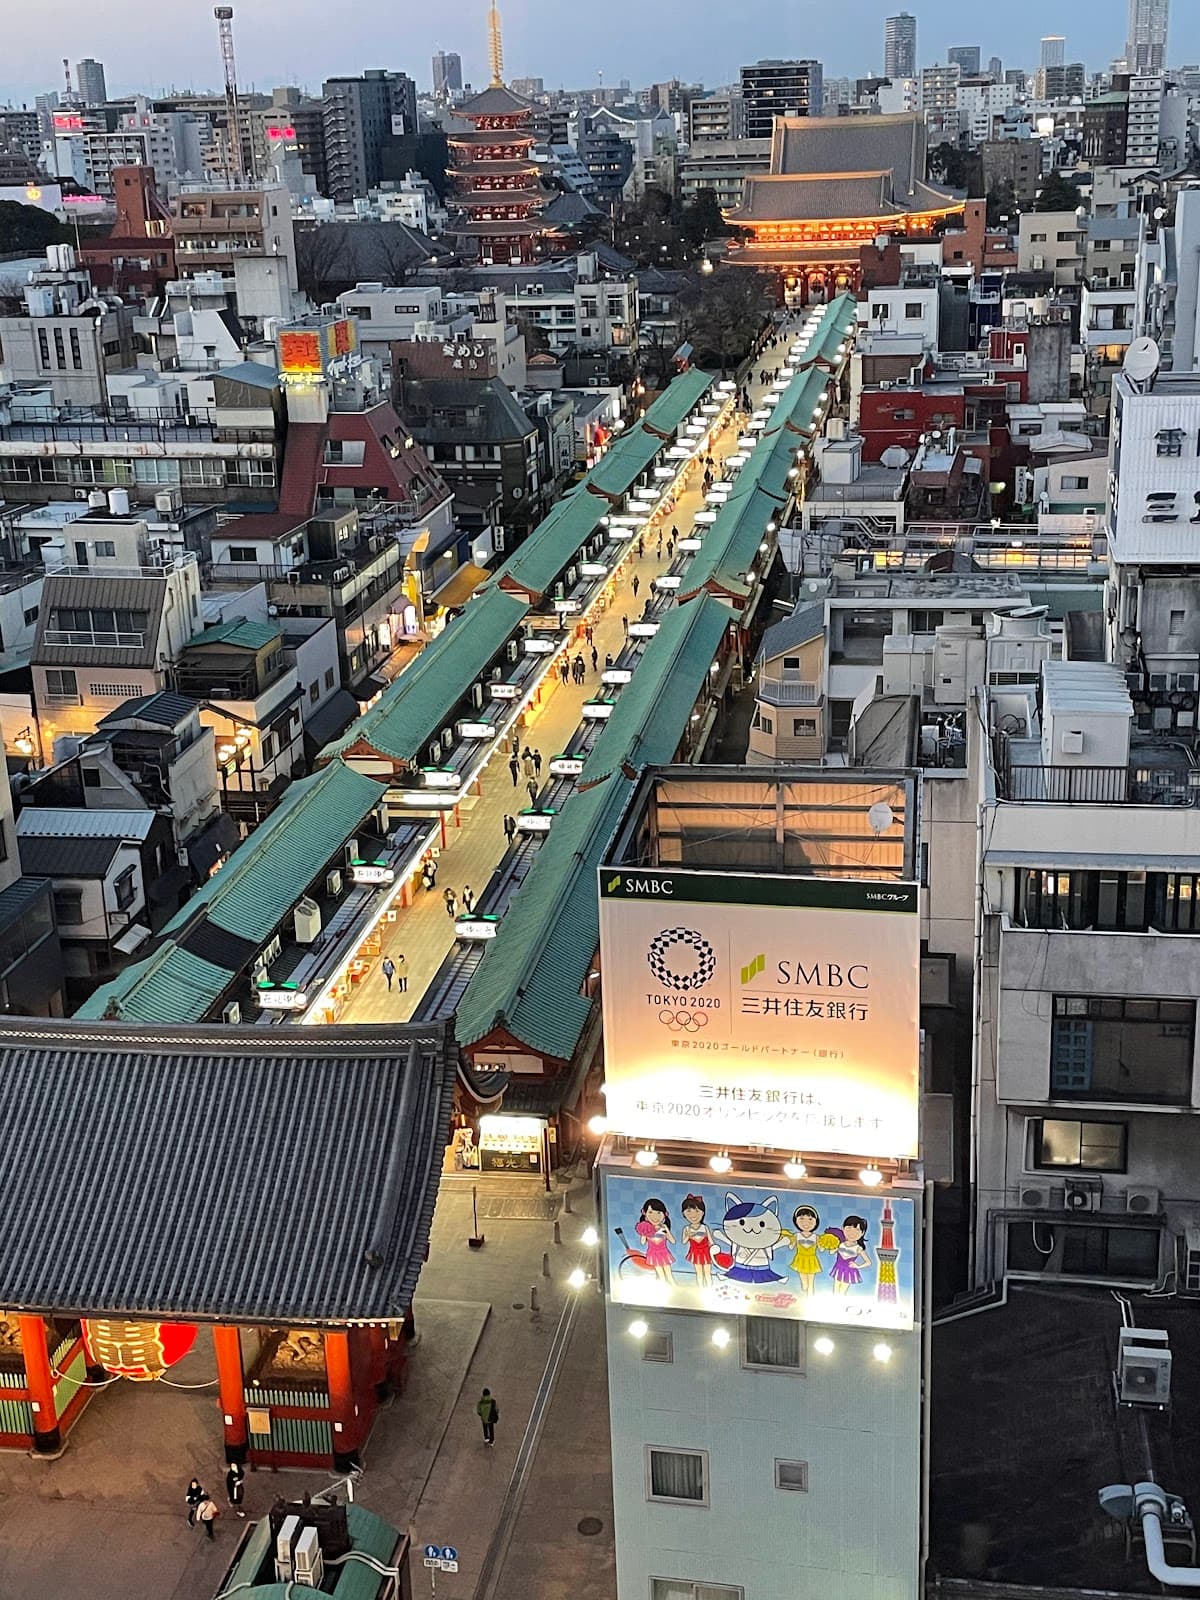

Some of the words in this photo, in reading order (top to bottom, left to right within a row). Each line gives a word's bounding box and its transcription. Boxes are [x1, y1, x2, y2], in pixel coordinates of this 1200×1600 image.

[1153, 428, 1200, 457] 雷
[625, 878, 673, 894] SMBC
[866, 892, 909, 901] SMBCグループ
[777, 960, 869, 989] SMBC
[646, 994, 687, 1006] TOKYO
[690, 997, 720, 1008] 2020
[741, 997, 869, 1021] 三井住友銀行
[700, 1085, 823, 1106] 三井住友銀行は、
